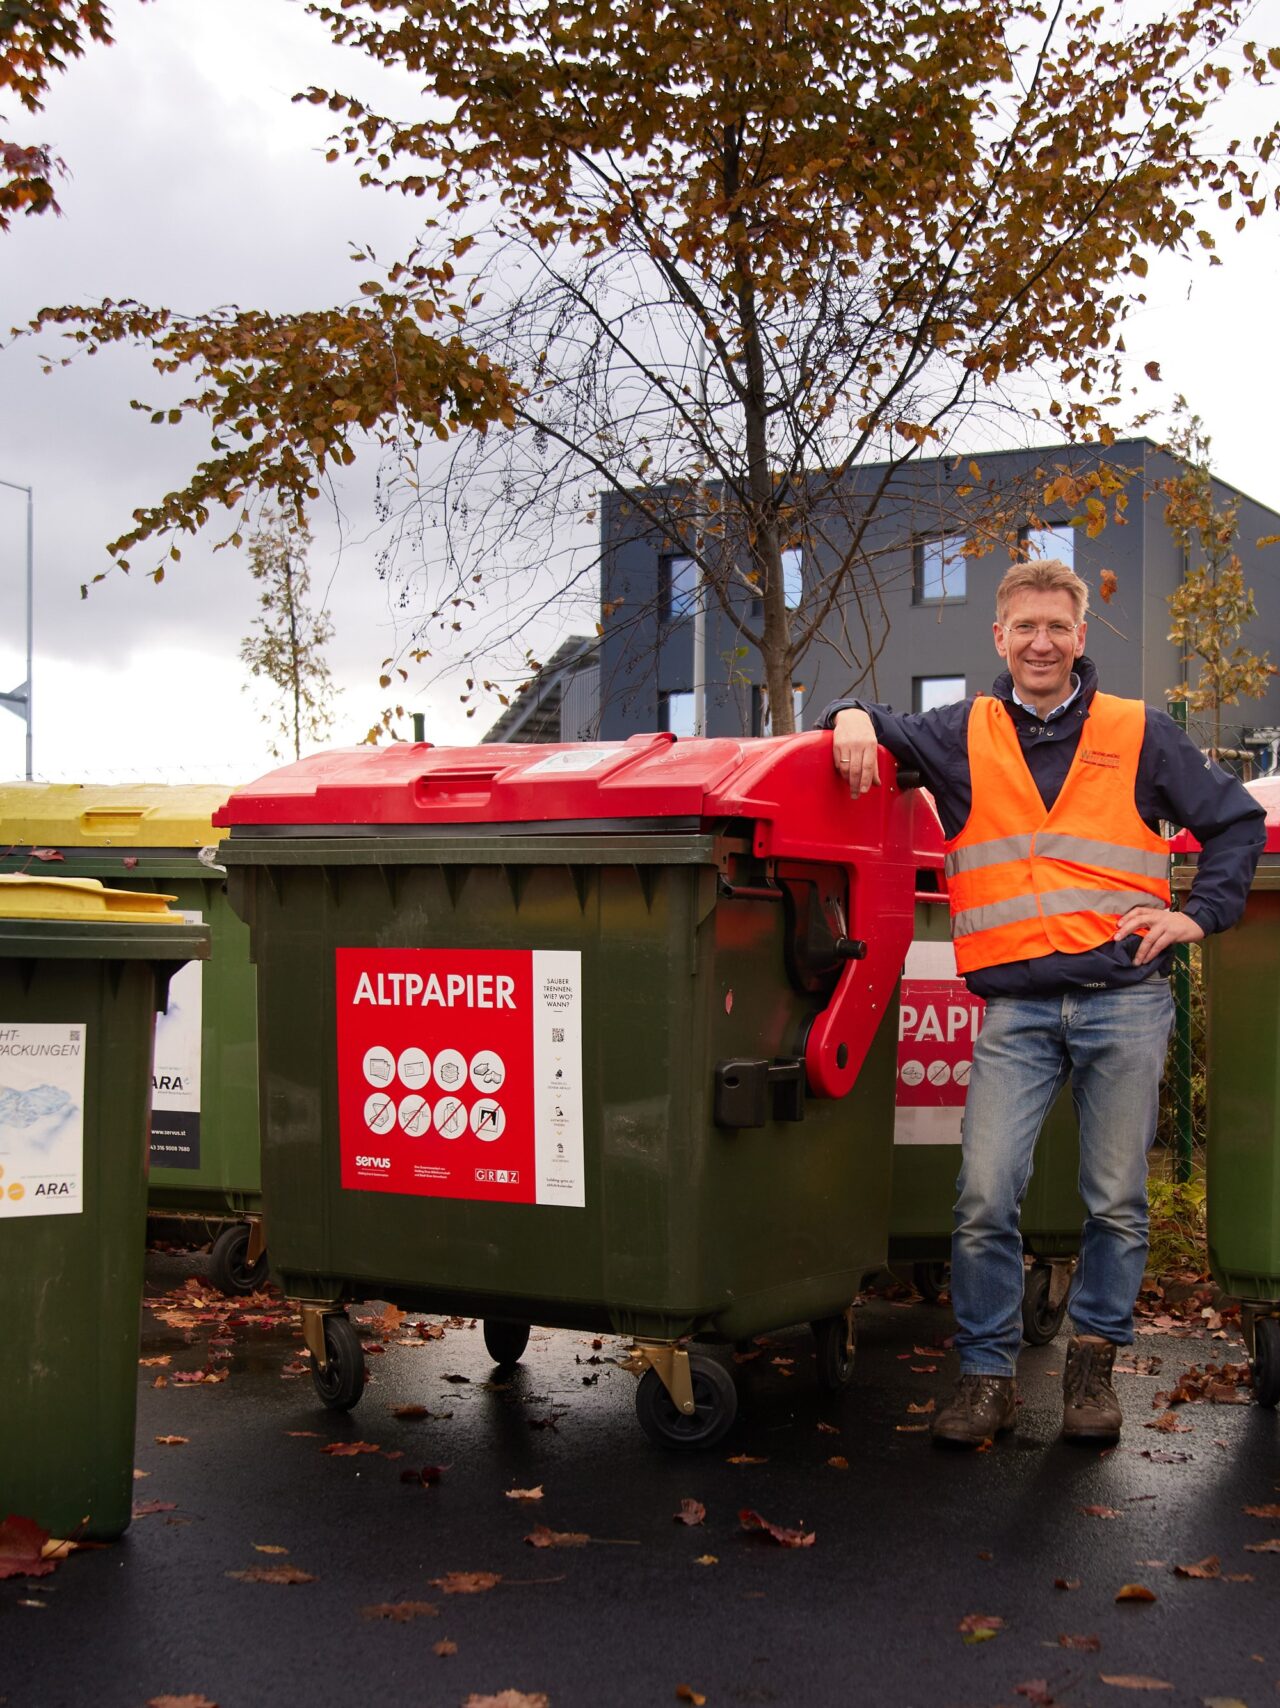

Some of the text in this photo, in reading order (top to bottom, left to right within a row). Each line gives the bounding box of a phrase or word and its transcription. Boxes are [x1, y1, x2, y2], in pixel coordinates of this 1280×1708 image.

[546, 977, 569, 985] SAUBER
[352, 971, 517, 1010] ALTPAPIER
[559, 993, 573, 1001] WO?
[546, 1000, 570, 1008] WANN?
[898, 1004, 986, 1042] PAPI
[355, 1155, 391, 1169] servus
[475, 1168, 519, 1184] GRAZ
[35, 1182, 69, 1196] ARA
